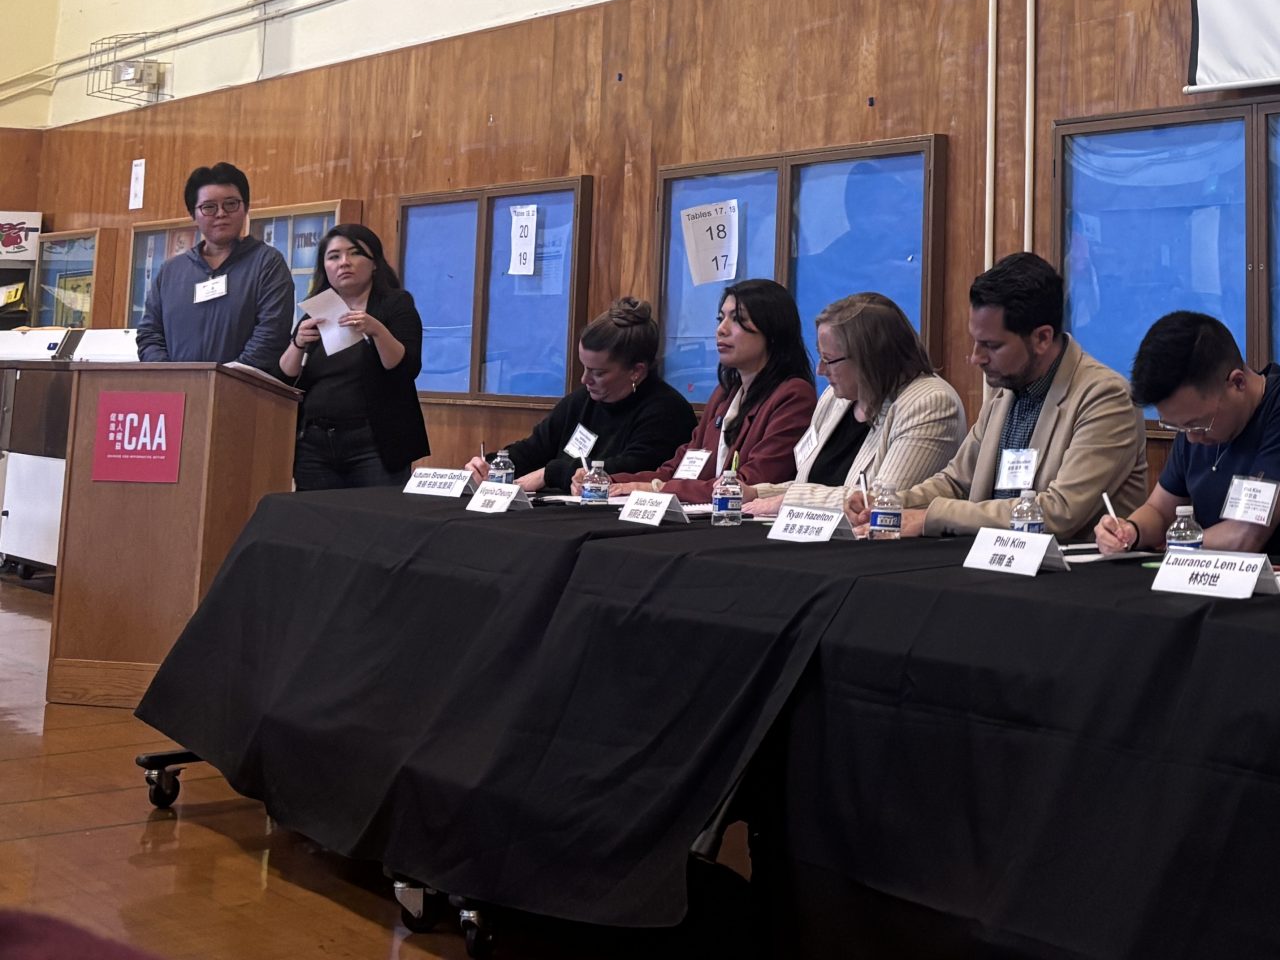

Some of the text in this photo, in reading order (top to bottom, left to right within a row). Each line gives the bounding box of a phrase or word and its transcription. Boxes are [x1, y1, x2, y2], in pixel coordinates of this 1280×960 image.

[686, 210, 712, 221] Tables
[519, 224, 529, 238] 20
[705, 224, 727, 240] 18
[519, 251, 528, 265] 19
[711, 254, 729, 271] 17
[123, 413, 167, 451] CAA
[786, 509, 834, 522] Ryan Hazelton
[993, 535, 1027, 550] Phil Kim
[1165, 555, 1258, 573] Laurance Lem Lee
